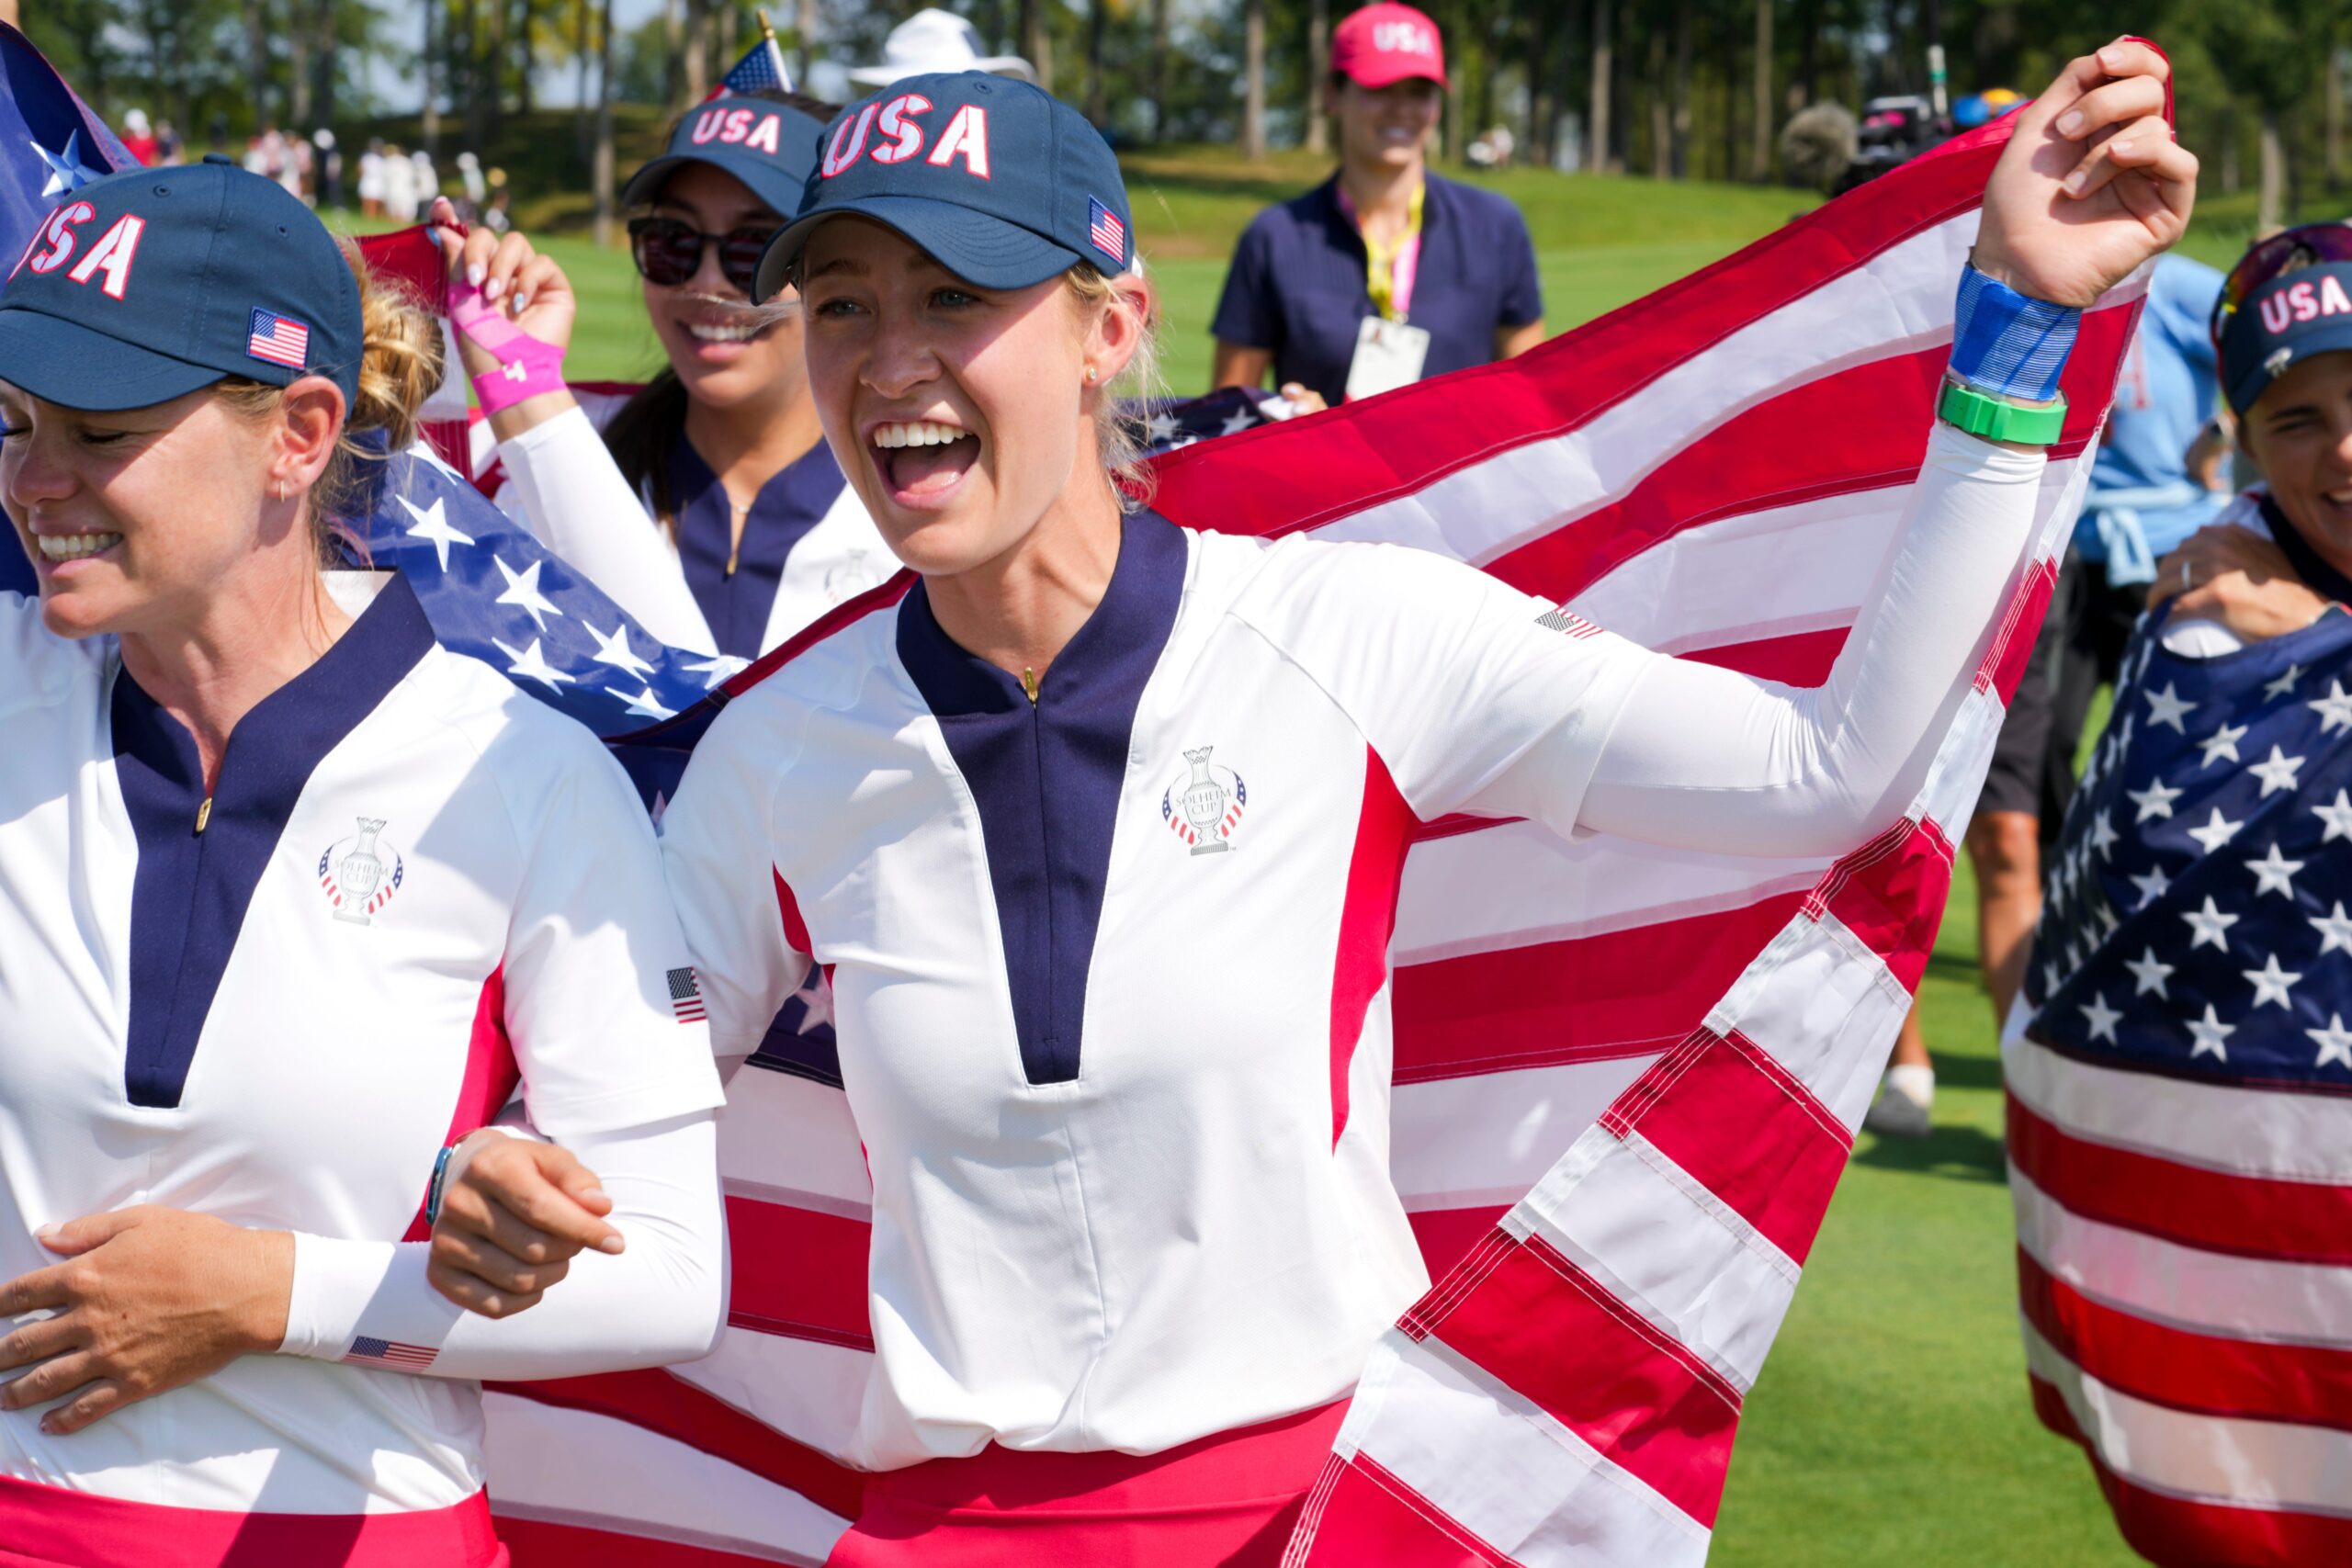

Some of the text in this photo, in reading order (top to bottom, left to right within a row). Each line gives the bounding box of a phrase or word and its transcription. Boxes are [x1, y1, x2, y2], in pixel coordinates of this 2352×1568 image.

[1373, 22, 1434, 57] USA
[692, 108, 780, 154] USA
[821, 94, 989, 180] USA
[6, 200, 146, 301] SA
[2260, 276, 2352, 333] USA
[1176, 788, 1231, 807] SOLHEIM
[1192, 801, 1217, 815] CUP
[345, 873, 372, 885] CUP
